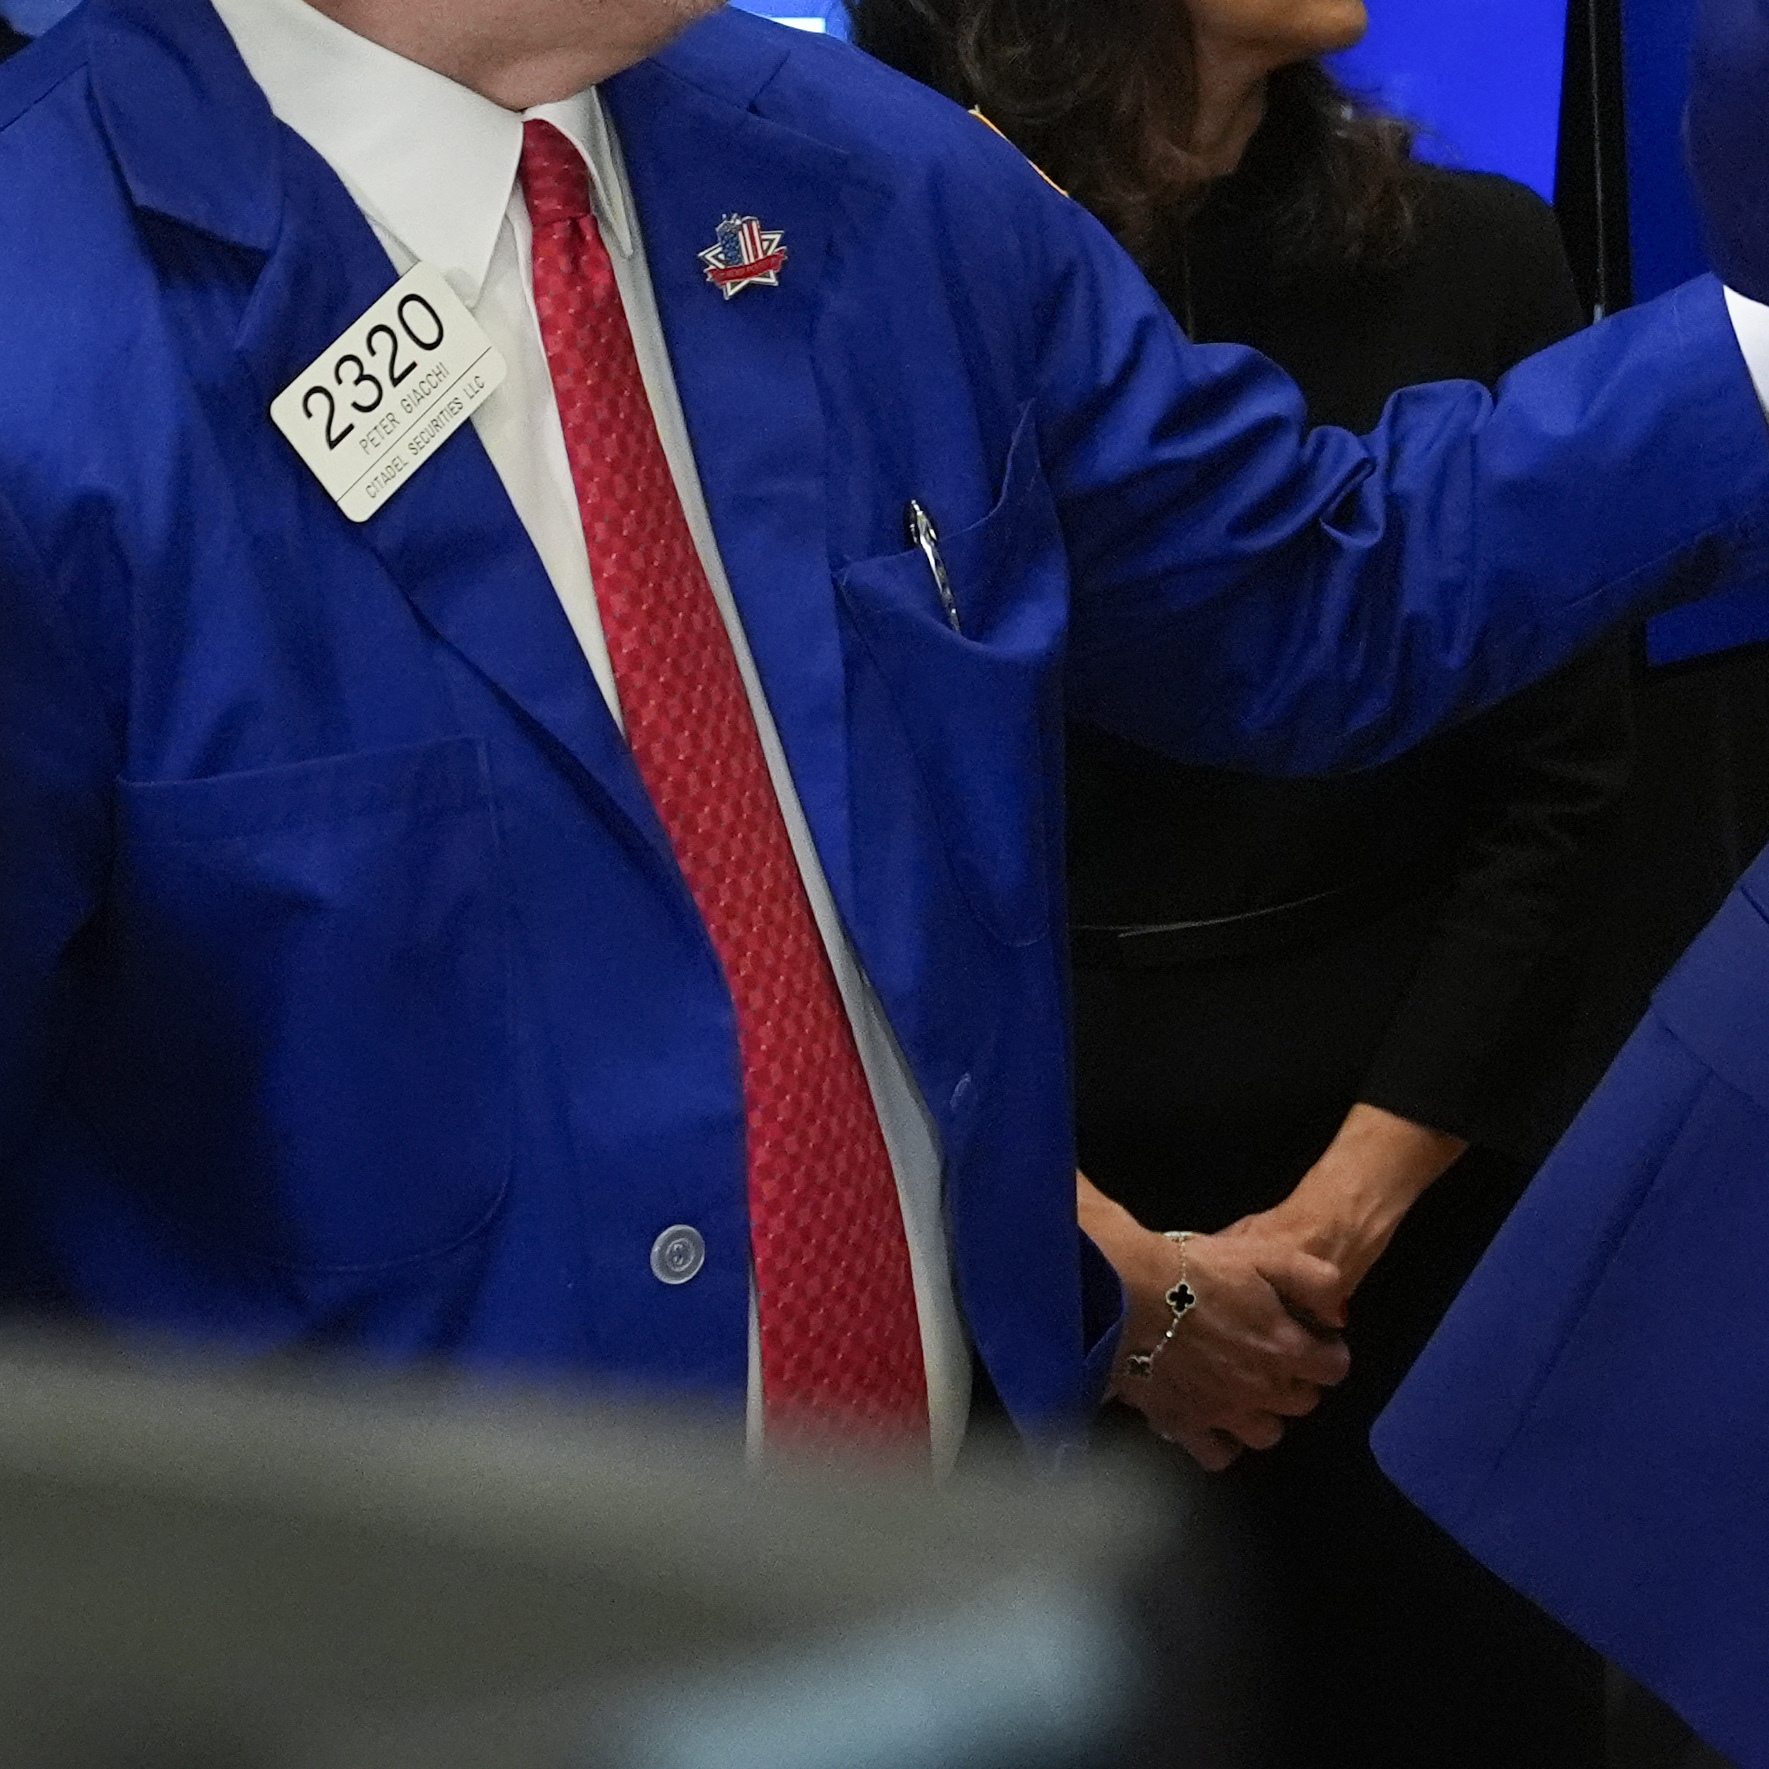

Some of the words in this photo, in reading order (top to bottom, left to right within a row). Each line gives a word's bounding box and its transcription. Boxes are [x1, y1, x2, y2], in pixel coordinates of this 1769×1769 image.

[302, 293, 444, 450] 2320
[359, 412, 401, 455] PETER
[400, 361, 450, 414] GIACCHI
[365, 455, 409, 499] CITADEL
[408, 396, 464, 456] SECURITIES
[465, 375, 486, 400] LLC
